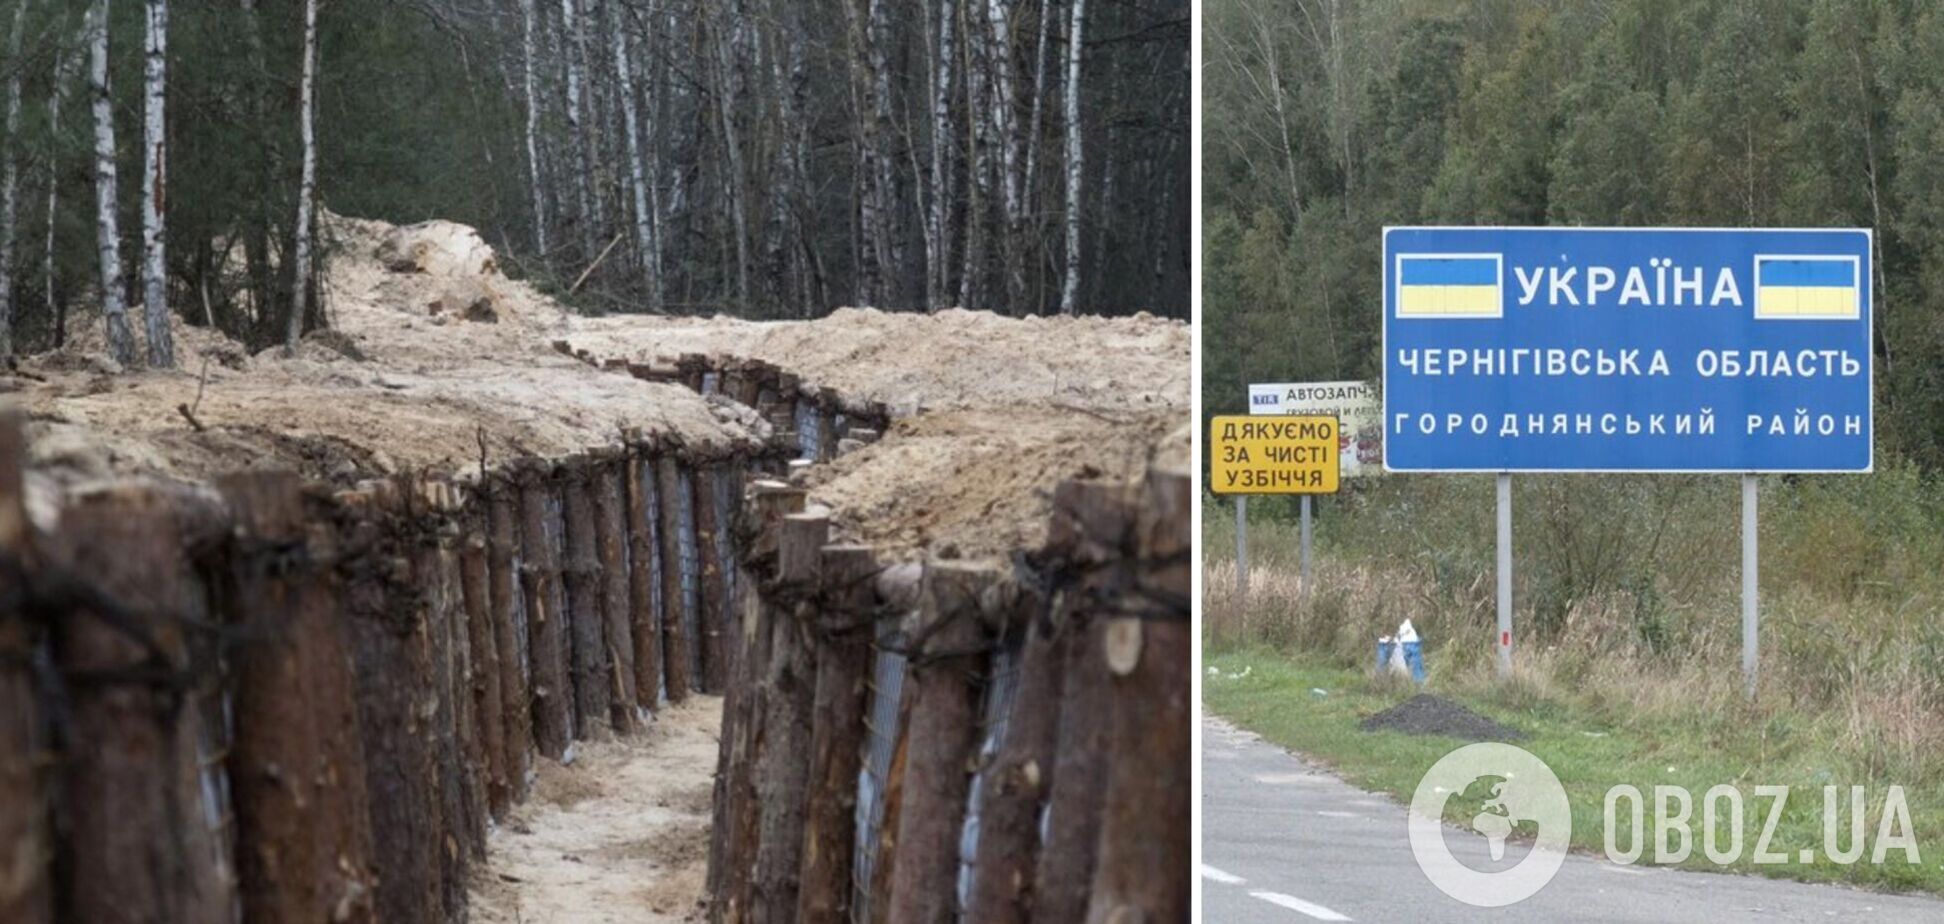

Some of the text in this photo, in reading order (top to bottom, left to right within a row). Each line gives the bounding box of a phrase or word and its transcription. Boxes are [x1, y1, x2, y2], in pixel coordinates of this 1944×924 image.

[1514, 257, 1743, 307] УКРАЇНА
[1398, 348, 1861, 377] ЧЕРНІГІВСЬКА ОБЛАСТЬ
[1221, 422, 1331, 442] ДЯКУЄМО
[1395, 408, 1862, 437] ГОРОДНЯНСЬКИЙ РАЙОН
[1223, 446, 1327, 463] ЗА ЧИСТІ
[1226, 470, 1322, 487] УЗБІЧЧЯ
